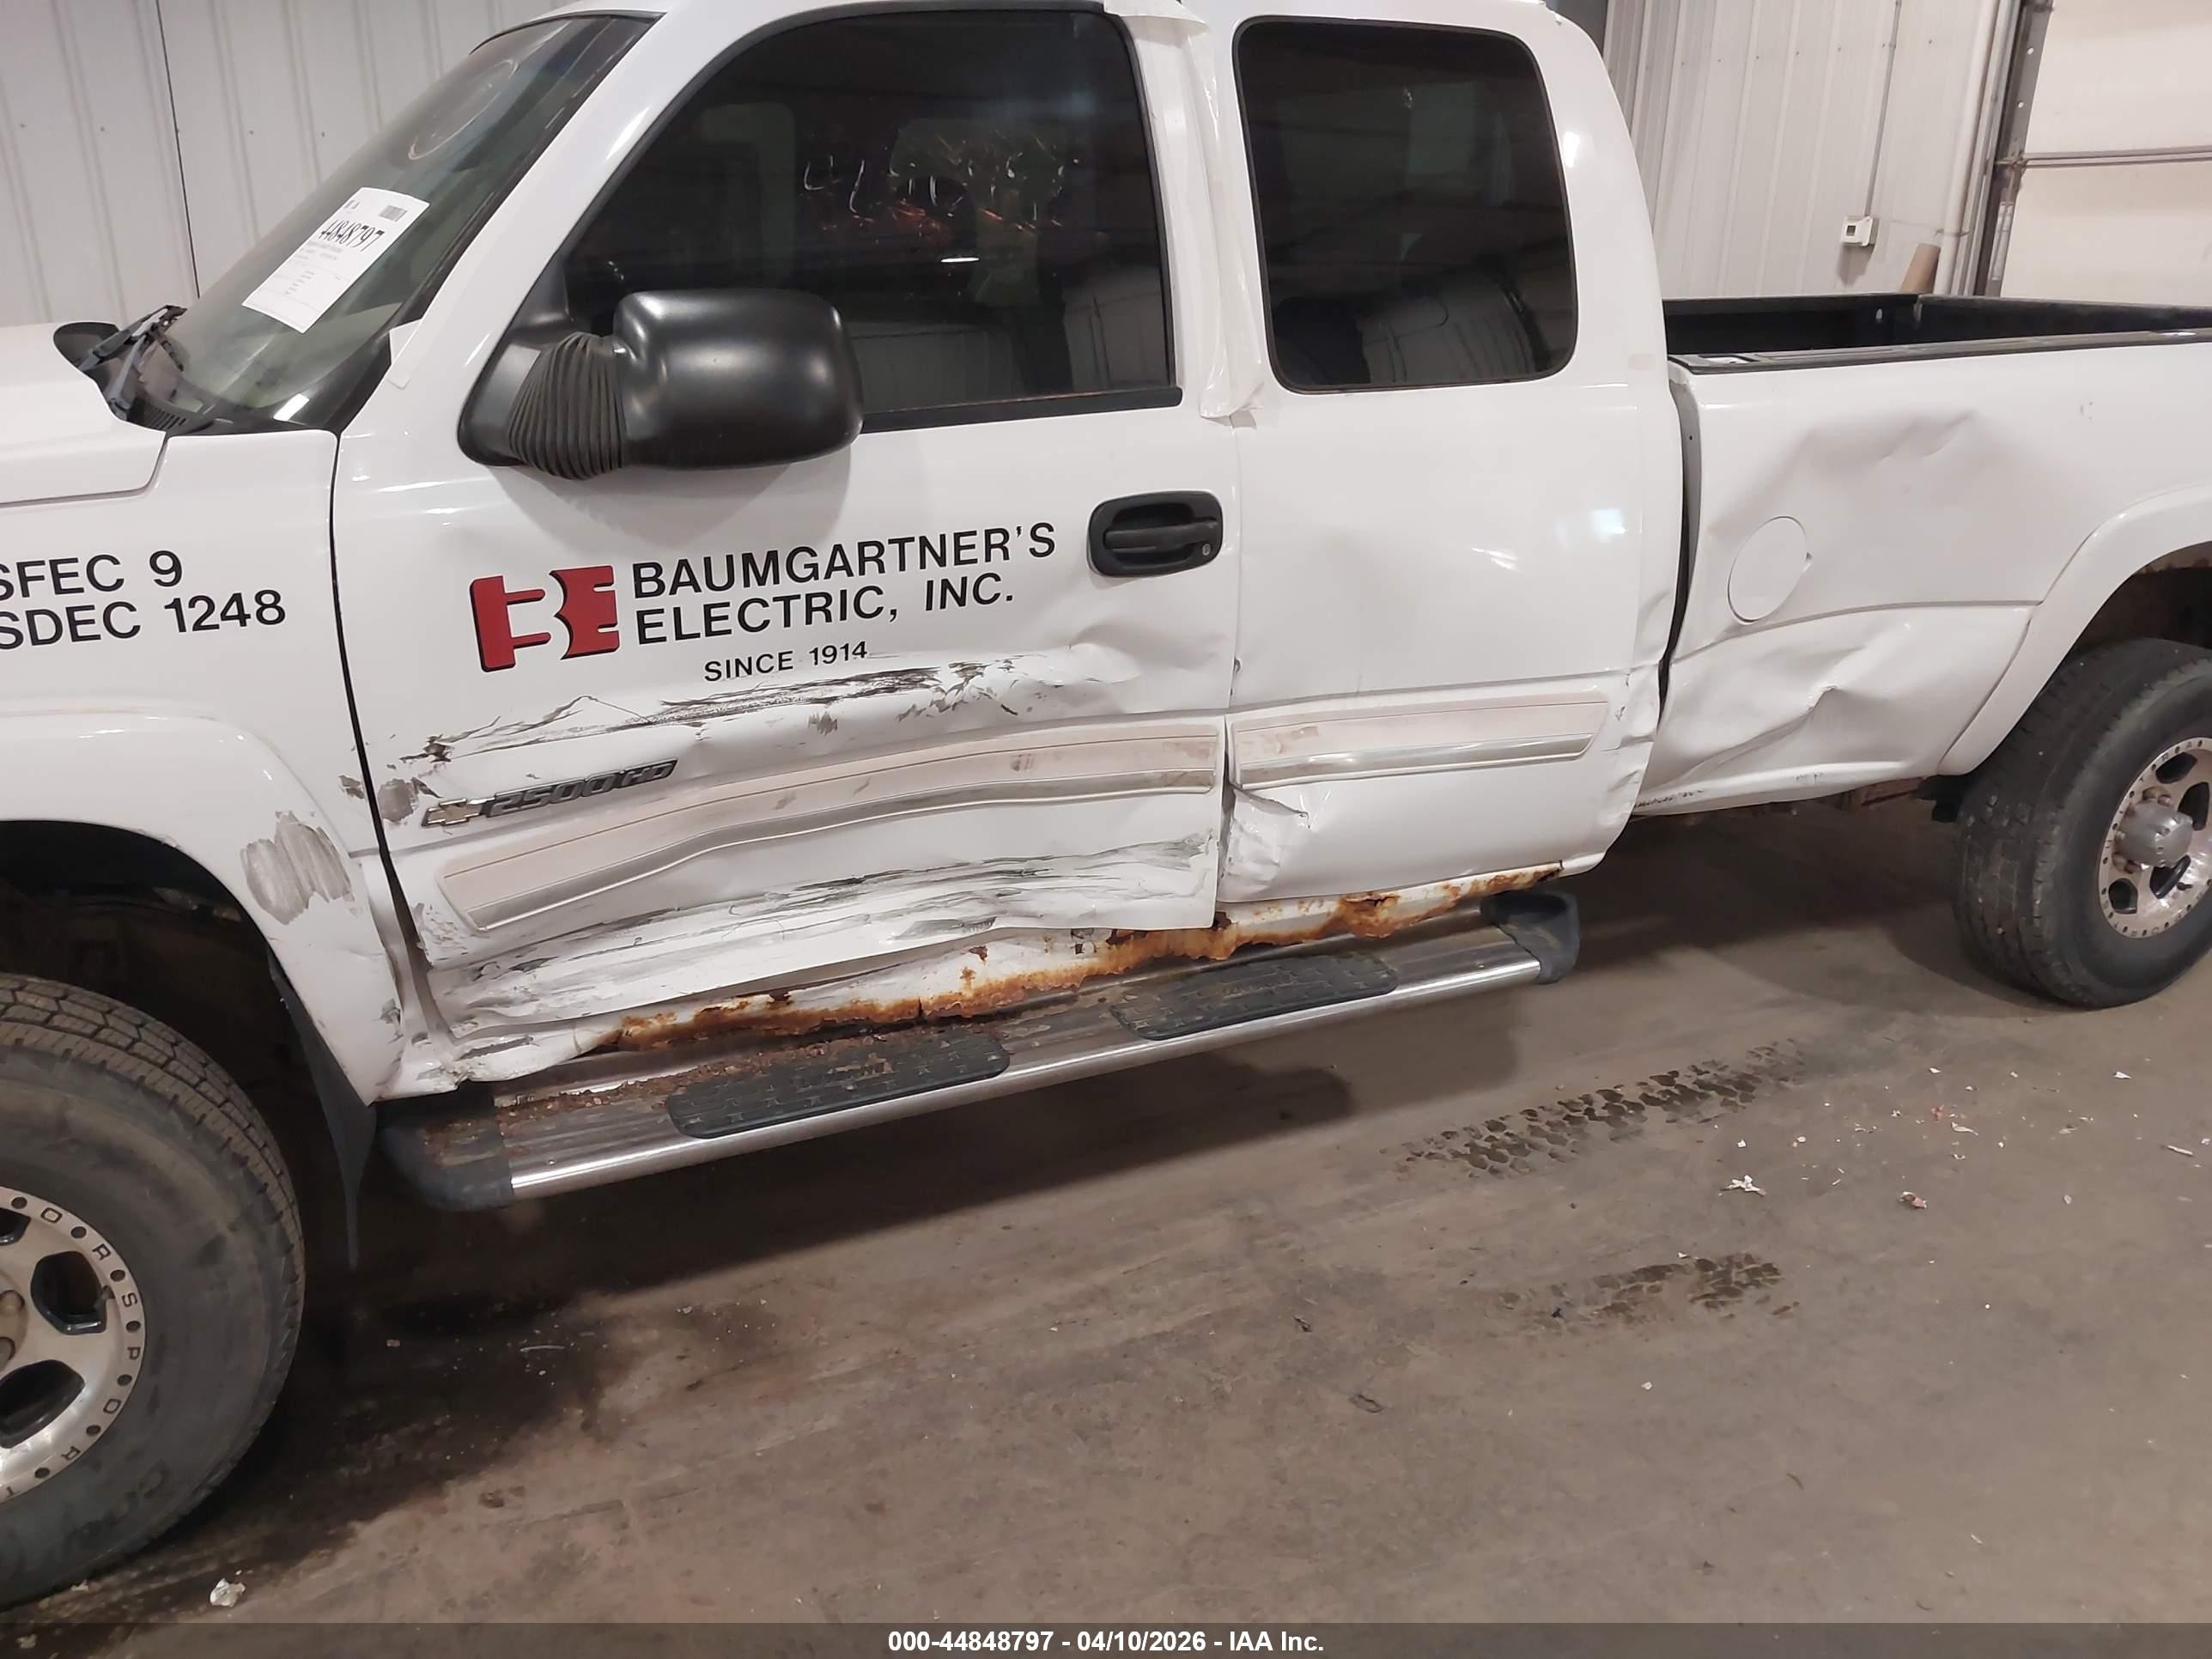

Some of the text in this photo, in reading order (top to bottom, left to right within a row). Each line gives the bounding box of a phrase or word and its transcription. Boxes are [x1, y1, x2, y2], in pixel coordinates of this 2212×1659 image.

[319, 219, 386, 252] 44848797
[149, 550, 183, 587] 9
[631, 521, 1057, 599] BAUMGARTNER'S
[163, 589, 286, 634] 1248
[635, 571, 1014, 646] ELECTRIC, INC.
[703, 640, 868, 683] SINCE 1914
